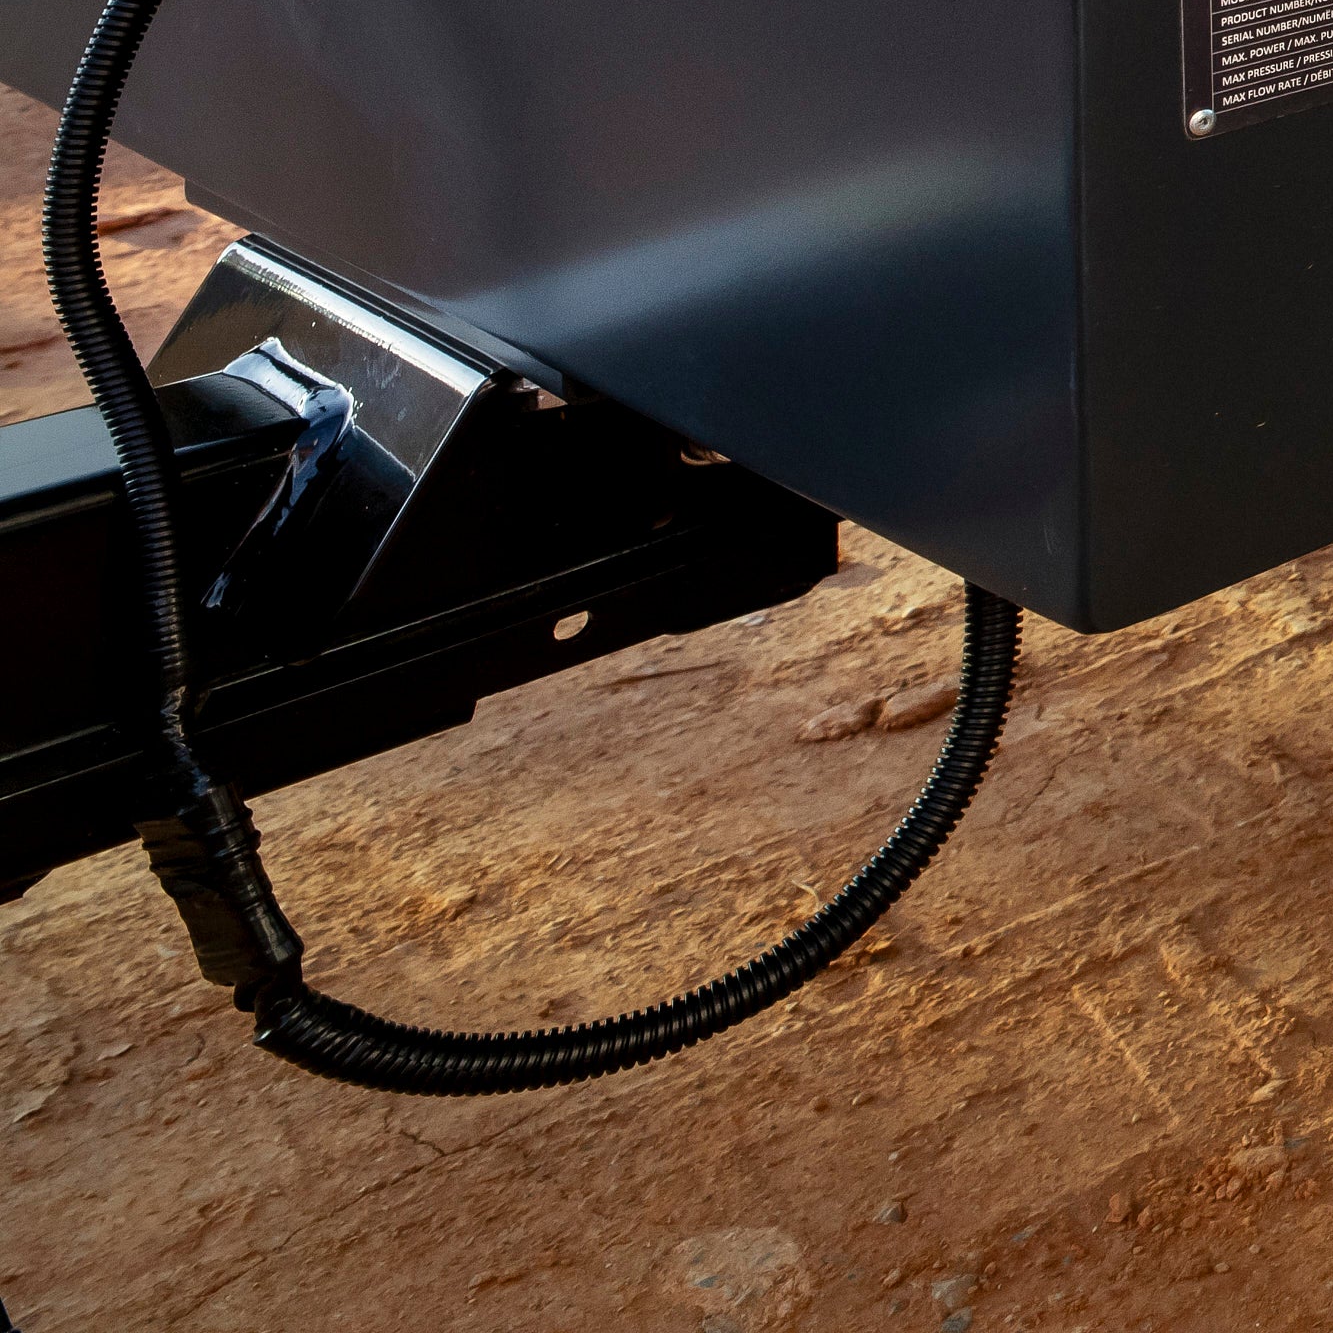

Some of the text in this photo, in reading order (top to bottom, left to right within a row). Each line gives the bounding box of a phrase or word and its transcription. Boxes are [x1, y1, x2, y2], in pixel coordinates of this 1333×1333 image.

[1220, 7, 1268, 27] PRODUCT
[1221, 30, 1255, 47] SERIAL
[1222, 71, 1246, 87] MAX
[1247, 58, 1295, 80] PRESSURE
[1222, 91, 1246, 107] MAX
[1247, 83, 1277, 100] FLOW
[1277, 76, 1302, 91] RATE
